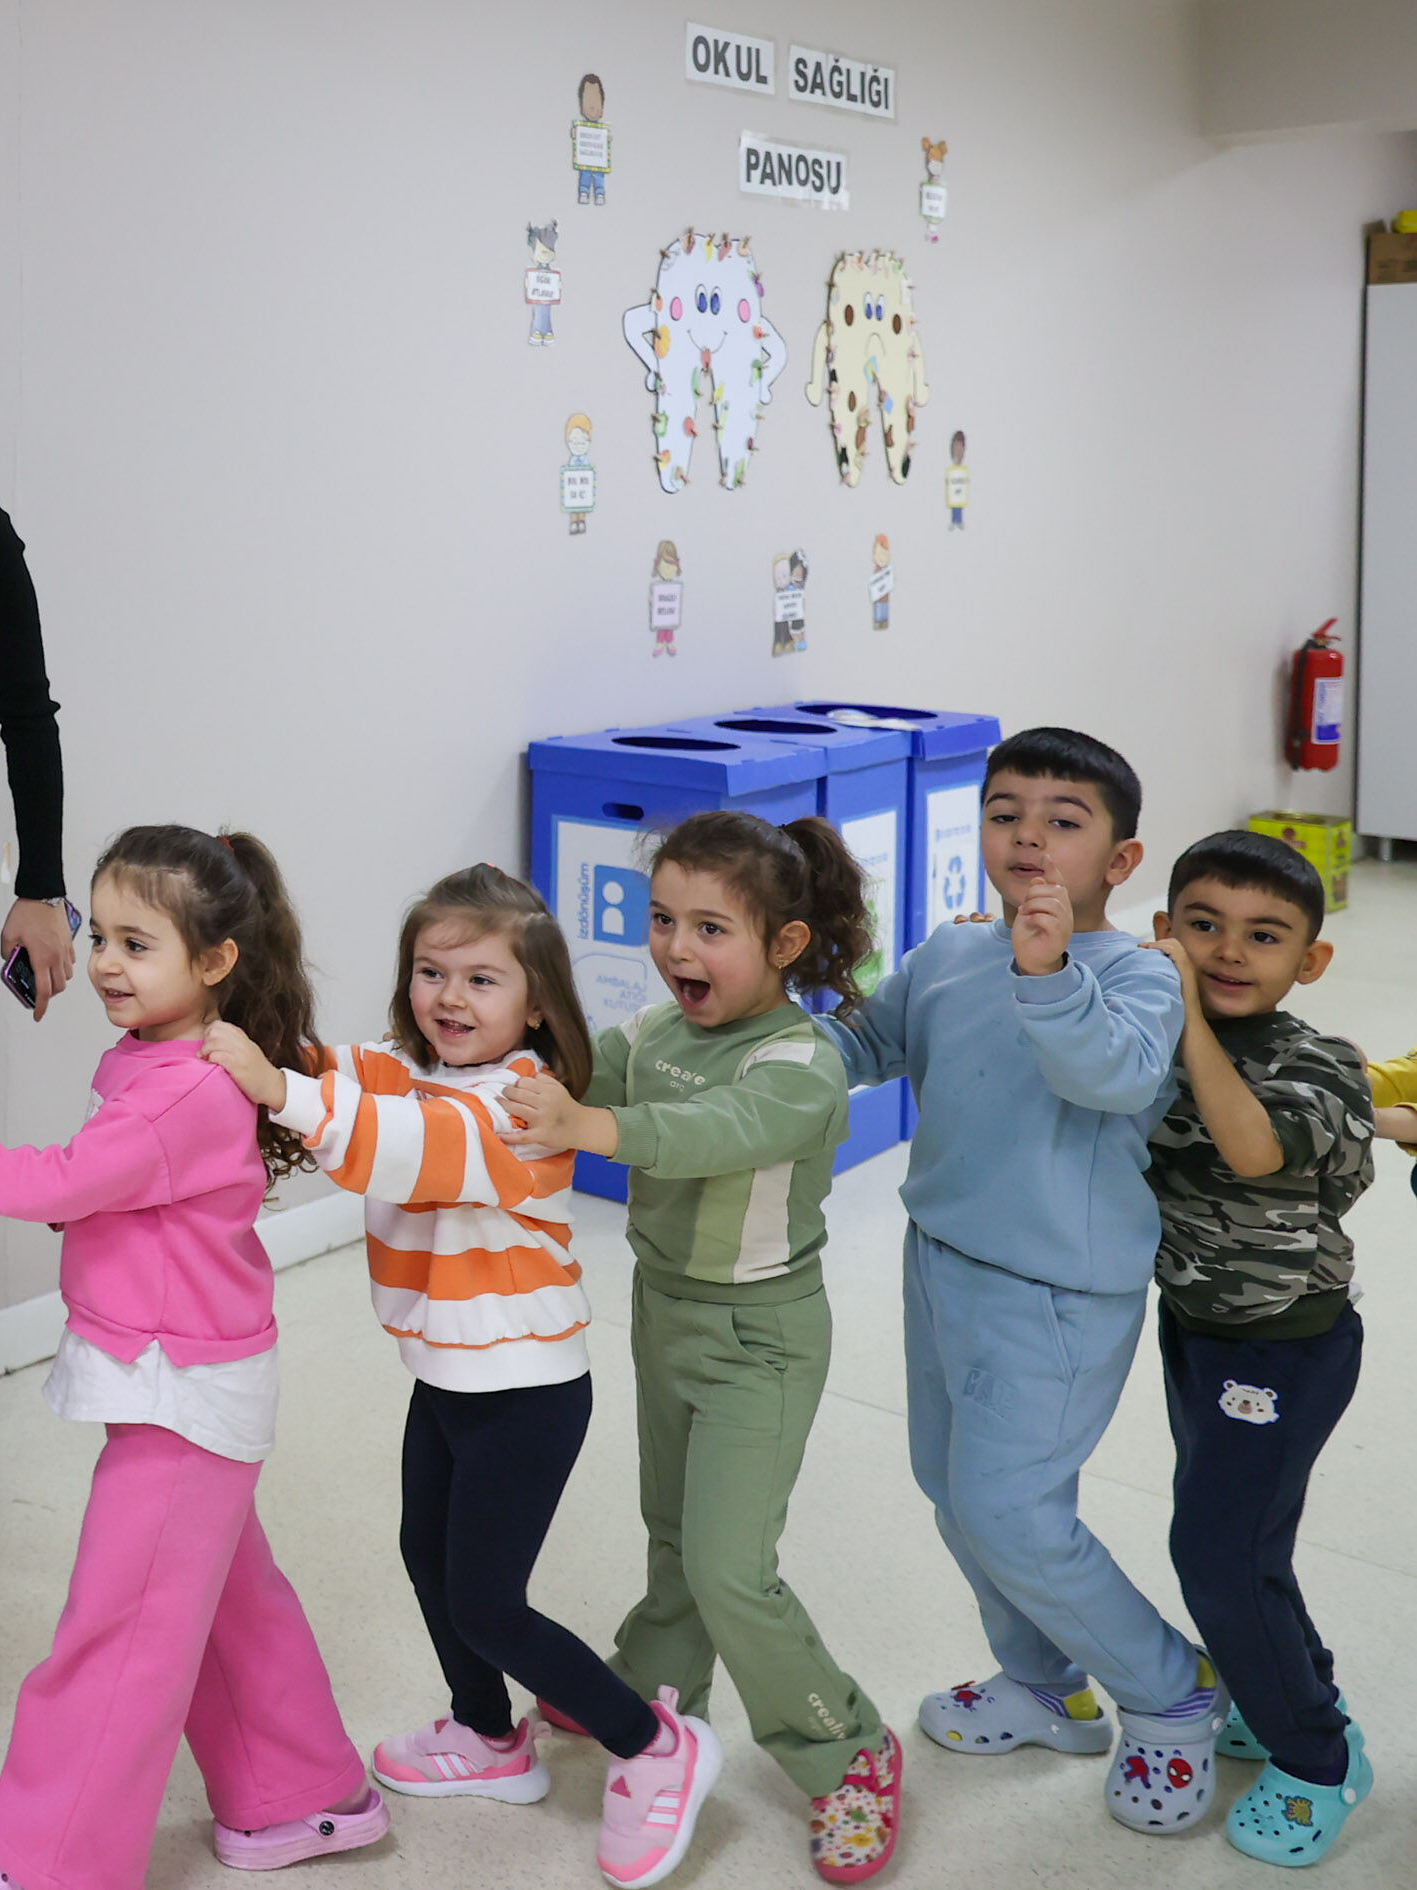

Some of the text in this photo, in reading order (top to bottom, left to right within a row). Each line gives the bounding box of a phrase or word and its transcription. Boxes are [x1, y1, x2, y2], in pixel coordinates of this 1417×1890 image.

[692, 35, 889, 109] OKUL SAĞLIĞI
[746, 148, 841, 194] PANOSU
